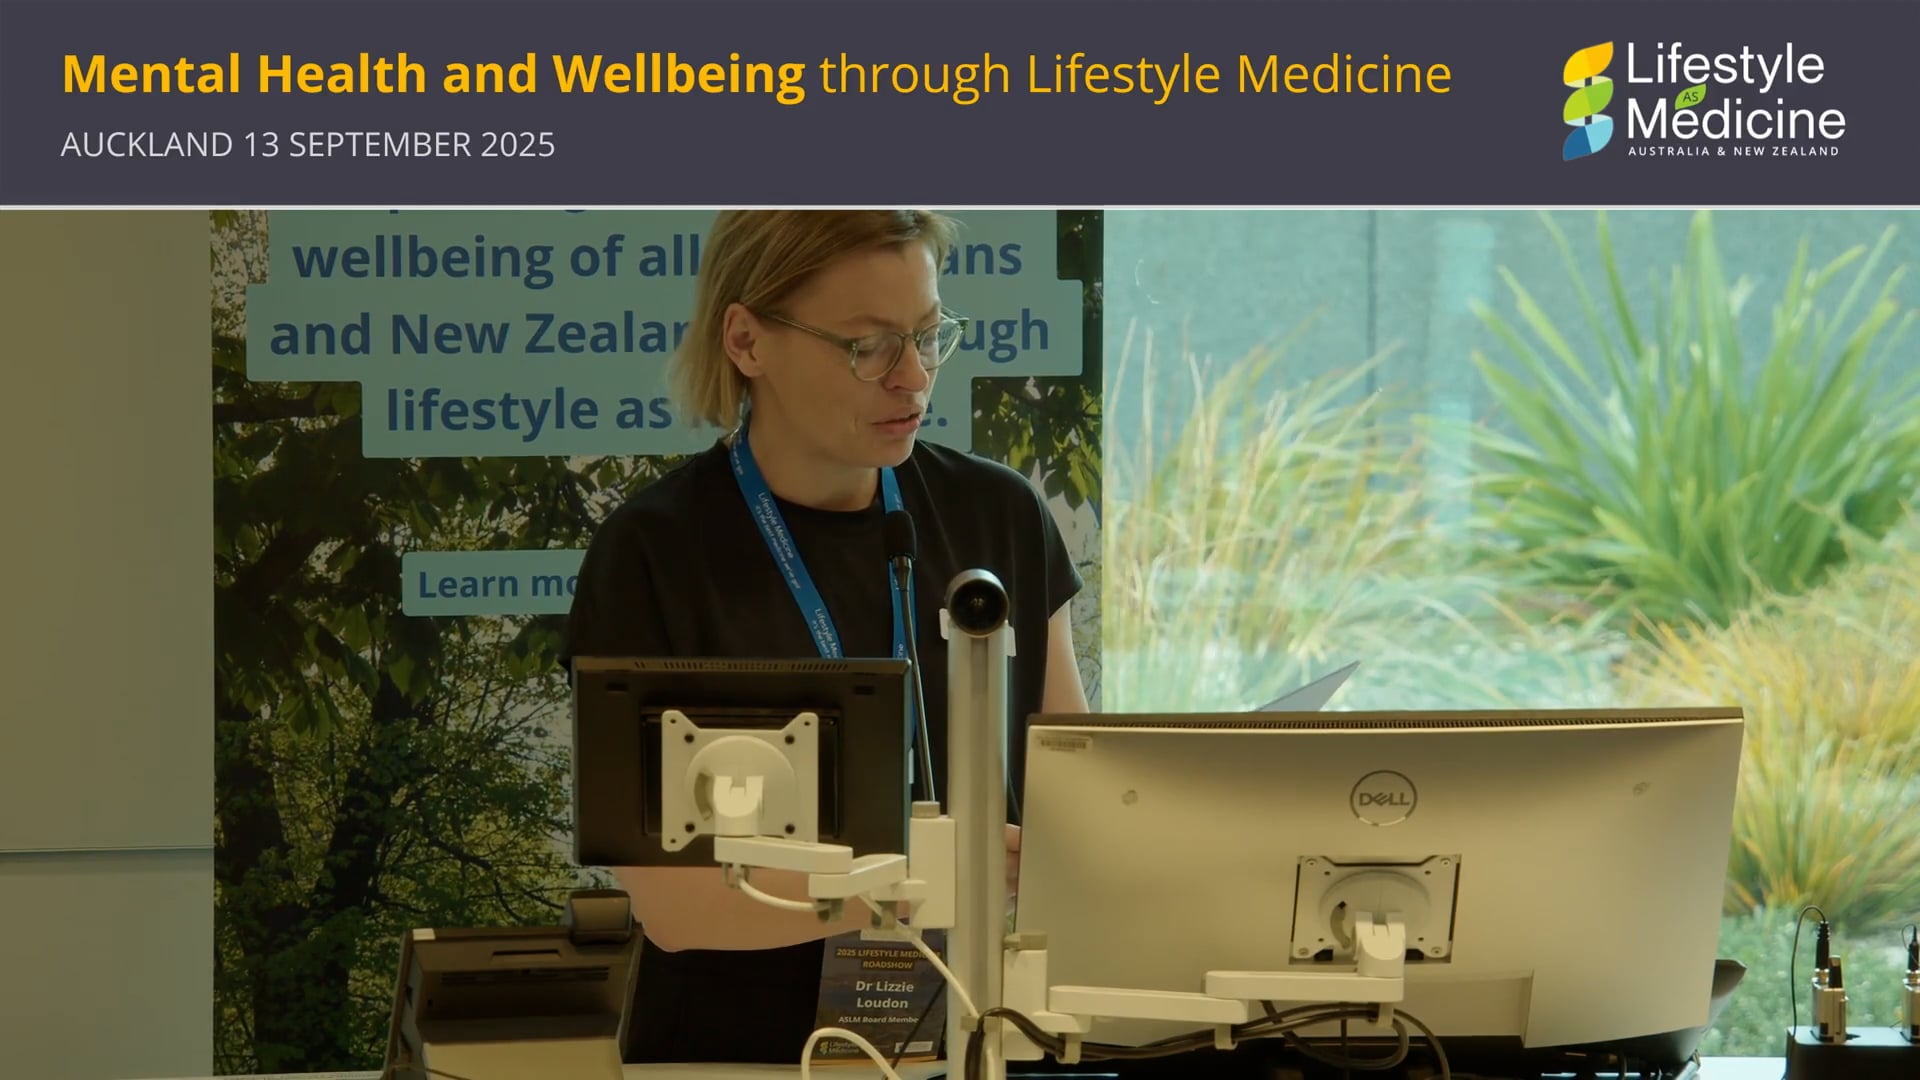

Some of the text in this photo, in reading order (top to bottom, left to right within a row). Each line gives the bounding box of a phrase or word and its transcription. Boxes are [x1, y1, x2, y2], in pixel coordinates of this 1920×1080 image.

[292, 233, 700, 290] wellbeing of all
[270, 311, 370, 356] and
[392, 313, 510, 355] New
[387, 387, 672, 443] lifestyle as
[419, 571, 518, 599] Learn
[1359, 792, 1410, 806] DELL
[836, 948, 857, 957] 2025
[858, 949, 898, 959] LIFESTYLE
[863, 961, 913, 970] ROADSHOW
[856, 980, 915, 993] Dr Lizzie
[856, 997, 909, 1009] Loudon
[838, 1016, 920, 1024] ASLM Board Membe
